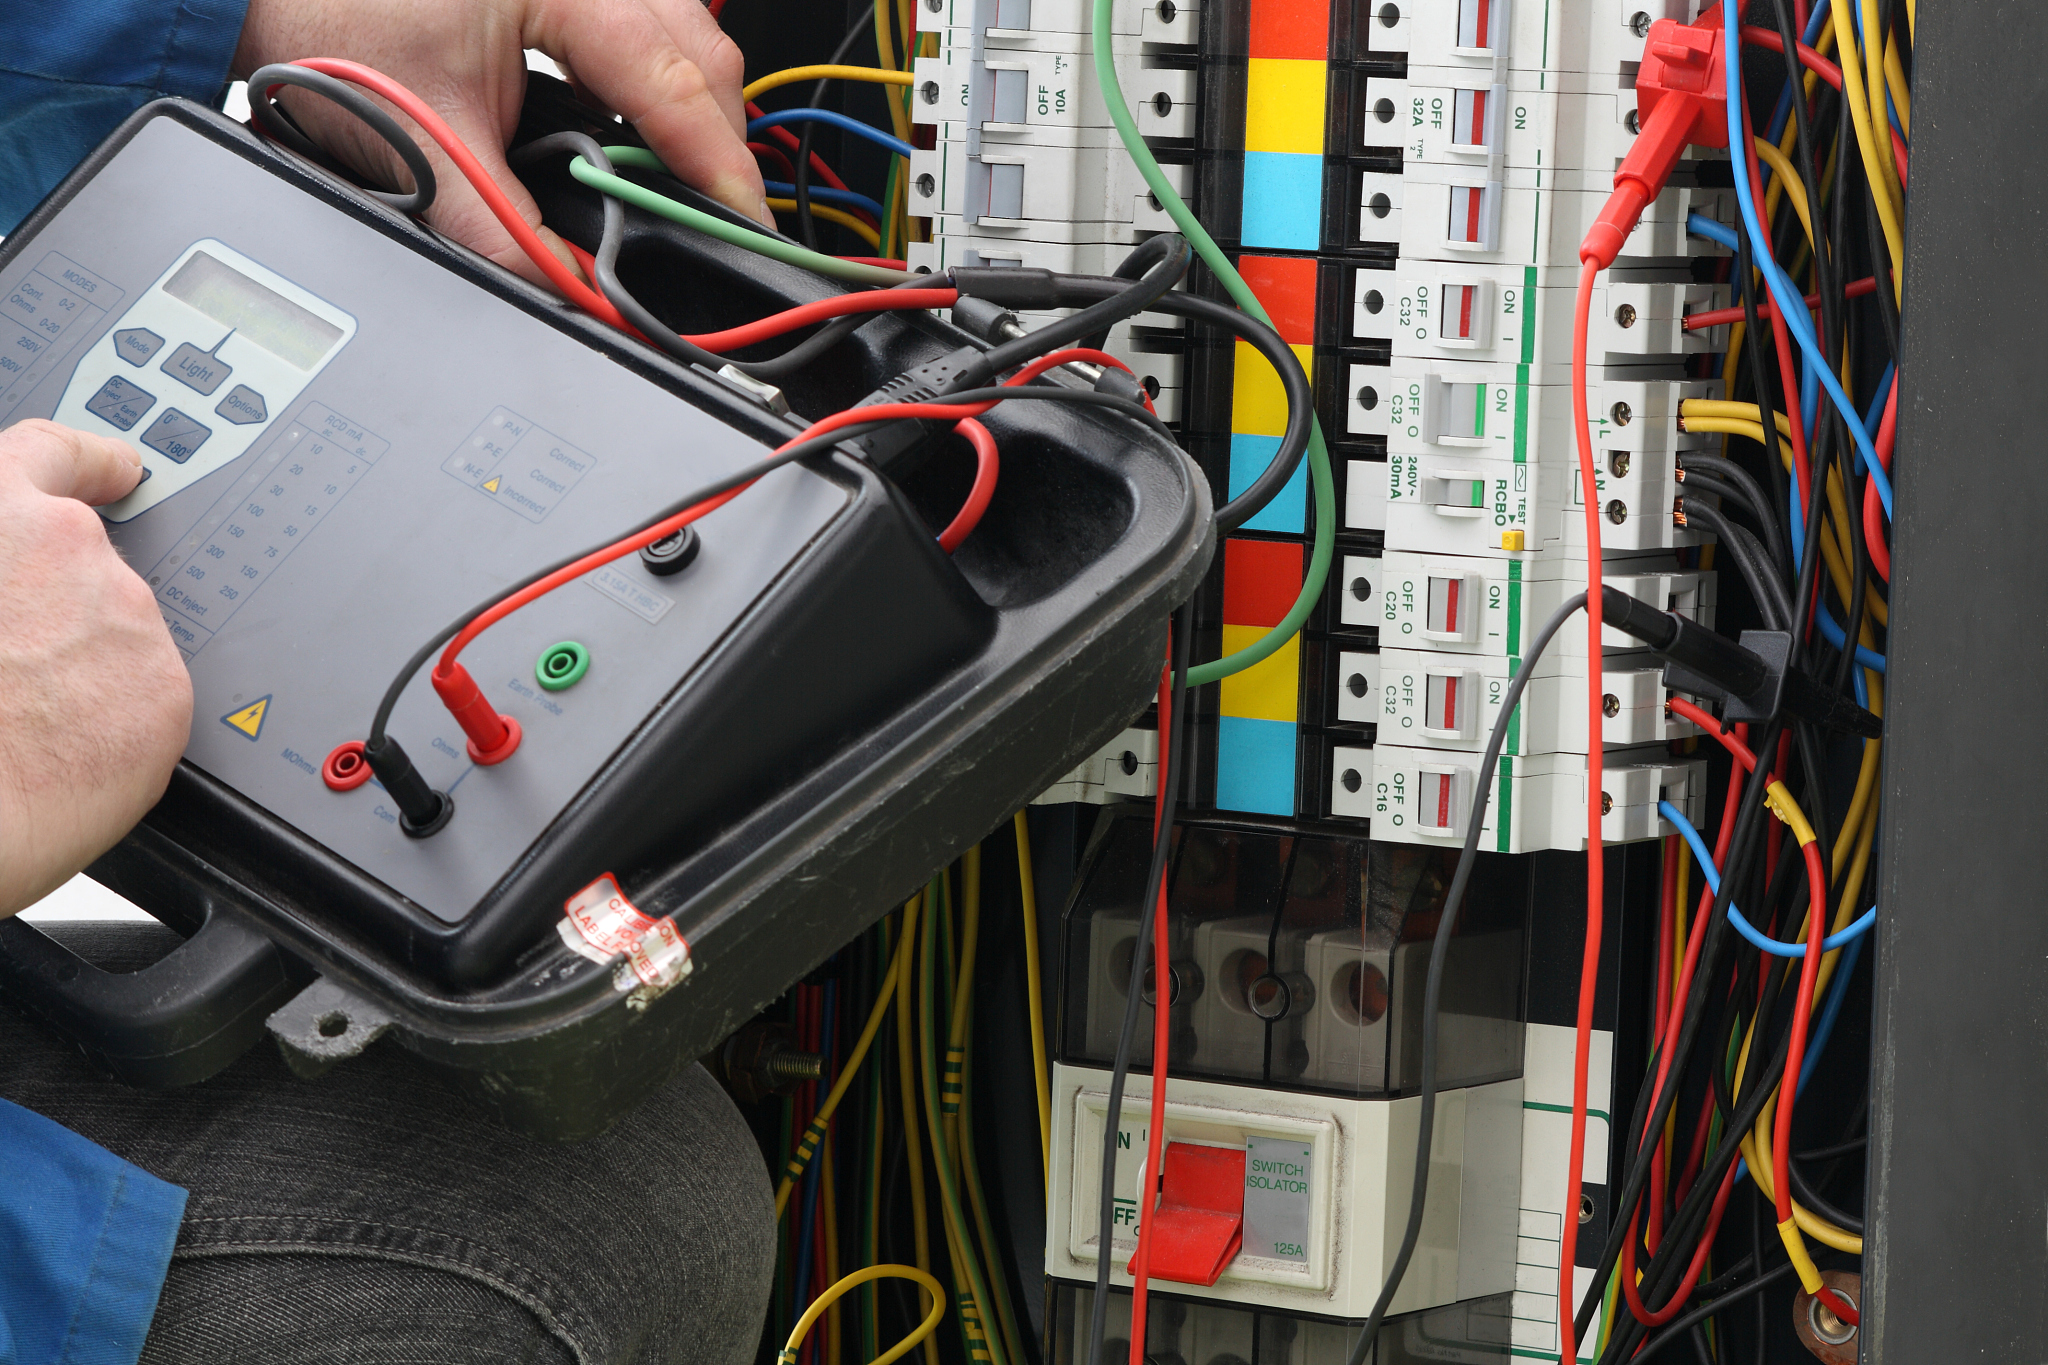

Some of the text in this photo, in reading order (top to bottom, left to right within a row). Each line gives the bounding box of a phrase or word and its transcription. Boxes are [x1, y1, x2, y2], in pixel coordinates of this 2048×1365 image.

[1037, 84, 1049, 116] OFF
[1055, 88, 1066, 115] 10A
[1412, 97, 1425, 128] 32A
[1430, 97, 1443, 130] OFF
[1514, 106, 1527, 130] ON
[1416, 138, 1424, 160] TYPE
[62, 269, 98, 293] MODES
[21, 283, 76, 312] Cont. 0-2
[1399, 296, 1411, 327] C32
[1416, 285, 1428, 319] OFF
[1503, 289, 1516, 314] ON
[10, 294, 61, 335] Ohms 0-20
[17, 336, 43, 354] 250V
[124, 334, 150, 355] Mode
[0, 356, 23, 373] 500V
[178, 356, 214, 383] Light
[102, 386, 122, 402] Inject
[110, 379, 123, 390] DC
[119, 404, 138, 420] Earth
[228, 395, 263, 420] Options
[1391, 394, 1403, 425] C32
[1408, 383, 1420, 417] OFF
[1495, 388, 1508, 413] ON
[112, 412, 132, 428] Probe
[321, 428, 333, 438] ac
[324, 414, 363, 442] RCD mA
[1599, 429, 1611, 439] L
[165, 440, 192, 458] 180°
[309, 443, 358, 475] 10 5
[355, 445, 367, 456] dc
[502, 421, 587, 474] P-N Correct
[288, 463, 338, 496] 20 10
[482, 441, 567, 495] P-E Correct
[1391, 456, 1403, 500] 30mA
[269, 484, 318, 517] 30 15
[462, 462, 547, 516] N-E Incorrect
[1494, 479, 1507, 527] RCBO
[246, 503, 298, 538] 100 50
[1517, 497, 1526, 525] TEST
[226, 523, 279, 559] 150 75
[205, 544, 259, 580] 300 150
[185, 565, 239, 601] 500 250
[1402, 580, 1414, 613] OFF
[1489, 585, 1501, 609] ON
[166, 586, 208, 616] DC Inject
[1385, 590, 1397, 620] C20
[169, 620, 195, 643] Temp.
[507, 678, 564, 717] Earth Probe
[1385, 685, 1397, 715] C32
[1402, 674, 1413, 707] OFF
[1489, 680, 1501, 705] ON
[280, 747, 318, 777] MOhms
[430, 736, 461, 759] Ohms
[1376, 782, 1388, 812] C16
[1393, 772, 1405, 805] OFF
[372, 804, 398, 825] Com
[574, 905, 612, 947] LABEL
[1252, 1159, 1304, 1177] SWITCH
[1246, 1175, 1308, 1195] ISOLATOR
[1273, 1241, 1304, 1257] 125A
